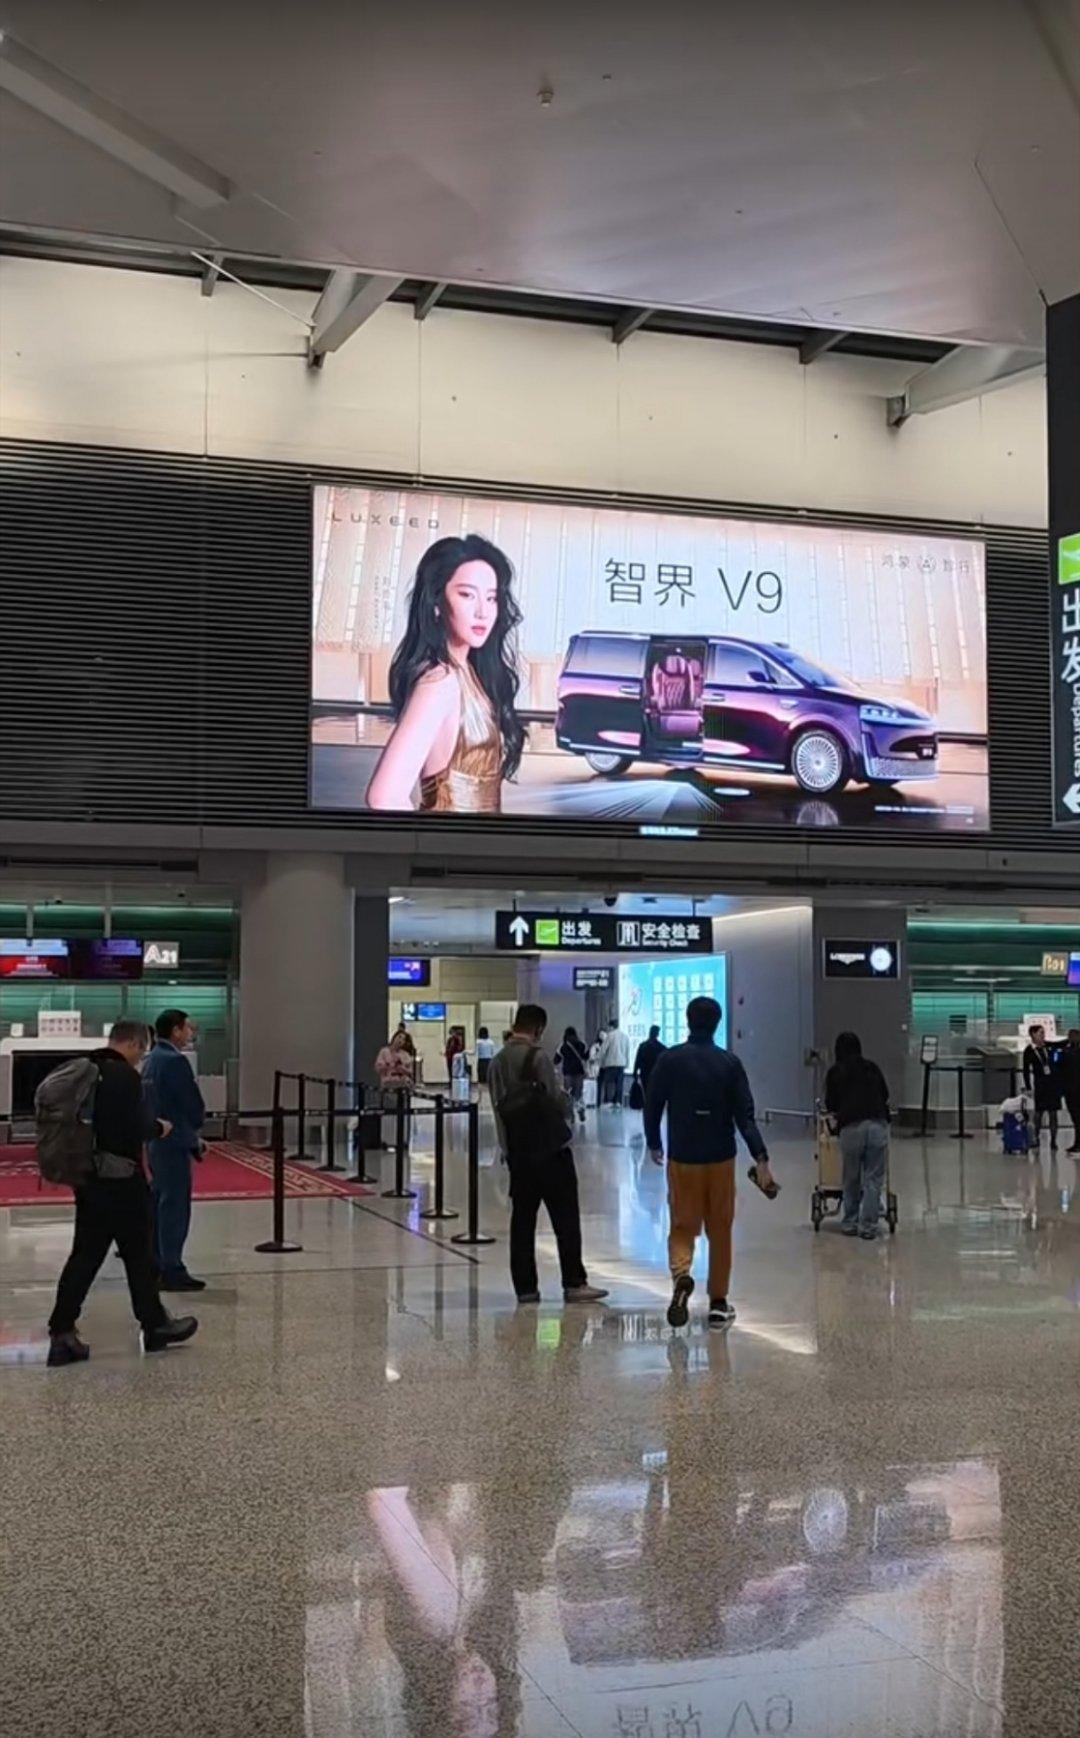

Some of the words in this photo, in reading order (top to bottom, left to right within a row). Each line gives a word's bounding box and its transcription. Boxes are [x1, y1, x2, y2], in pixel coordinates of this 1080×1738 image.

[331, 510, 440, 530] LUXEED
[605, 557, 696, 608] 智界
[717, 567, 783, 614] V9
[562, 921, 592, 937] 出发
[642, 922, 700, 939] 安全检查
[143, 944, 178, 964] A21
